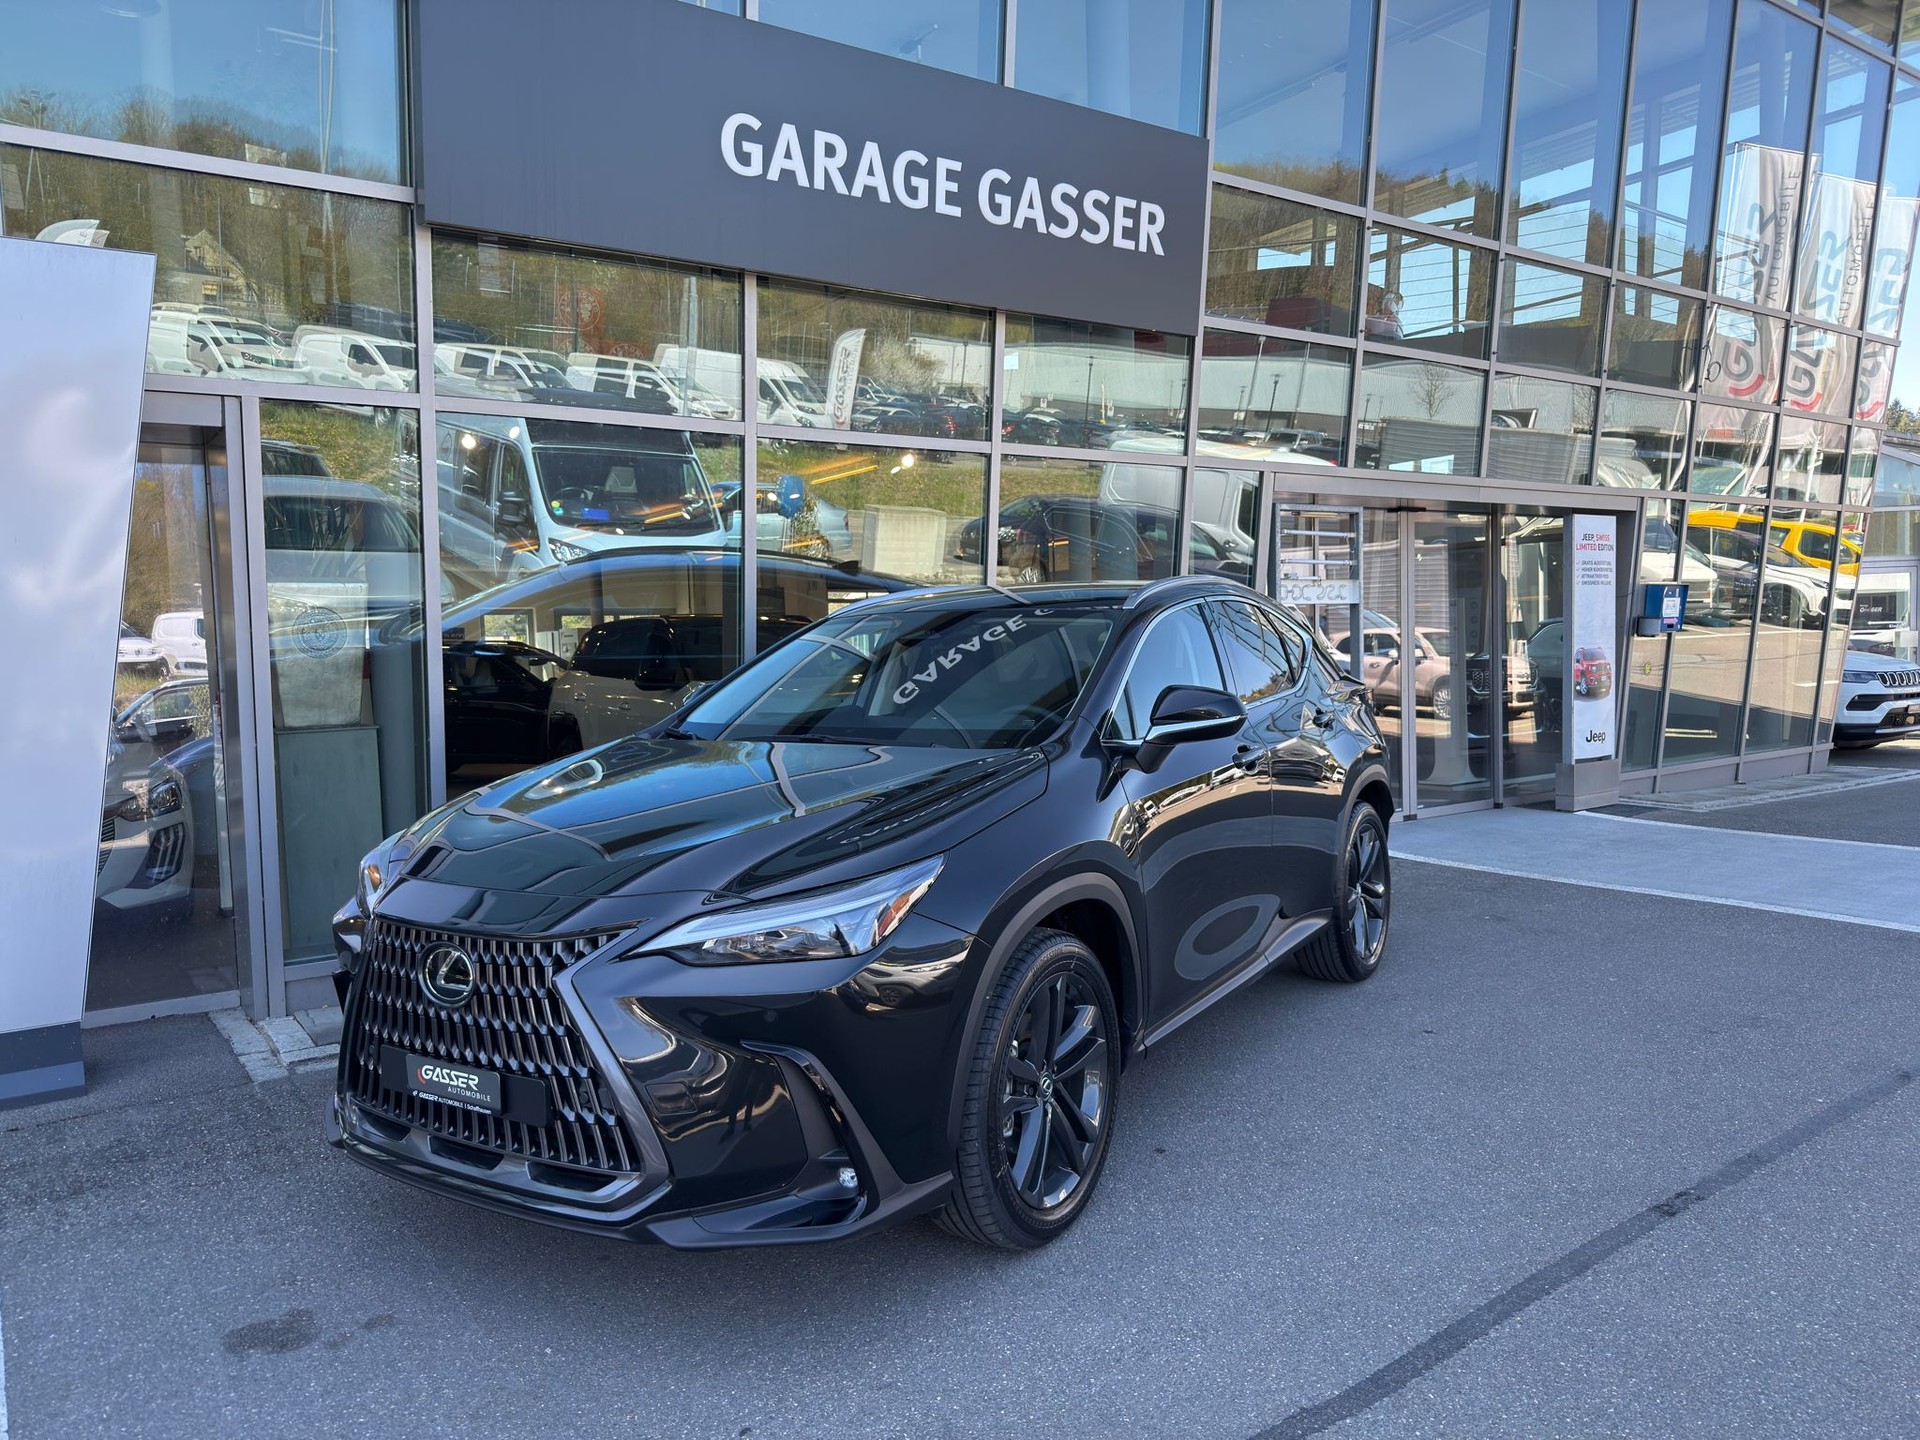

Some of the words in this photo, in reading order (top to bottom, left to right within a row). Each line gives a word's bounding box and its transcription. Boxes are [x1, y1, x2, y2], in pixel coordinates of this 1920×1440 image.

[721, 112, 963, 219] GARAGE
[977, 168, 1166, 256] GASSER
[1722, 201, 1777, 382] GASER
[1786, 230, 1852, 400] GASER
[1576, 543, 1597, 551] LIMITED
[1585, 729, 1606, 744] Jeep
[421, 1064, 479, 1091] GASSER
[418, 1091, 439, 1102] GASSER
[439, 1097, 464, 1108] AUTOMOBILE
[447, 1086, 491, 1102] AUTOMOBILE
